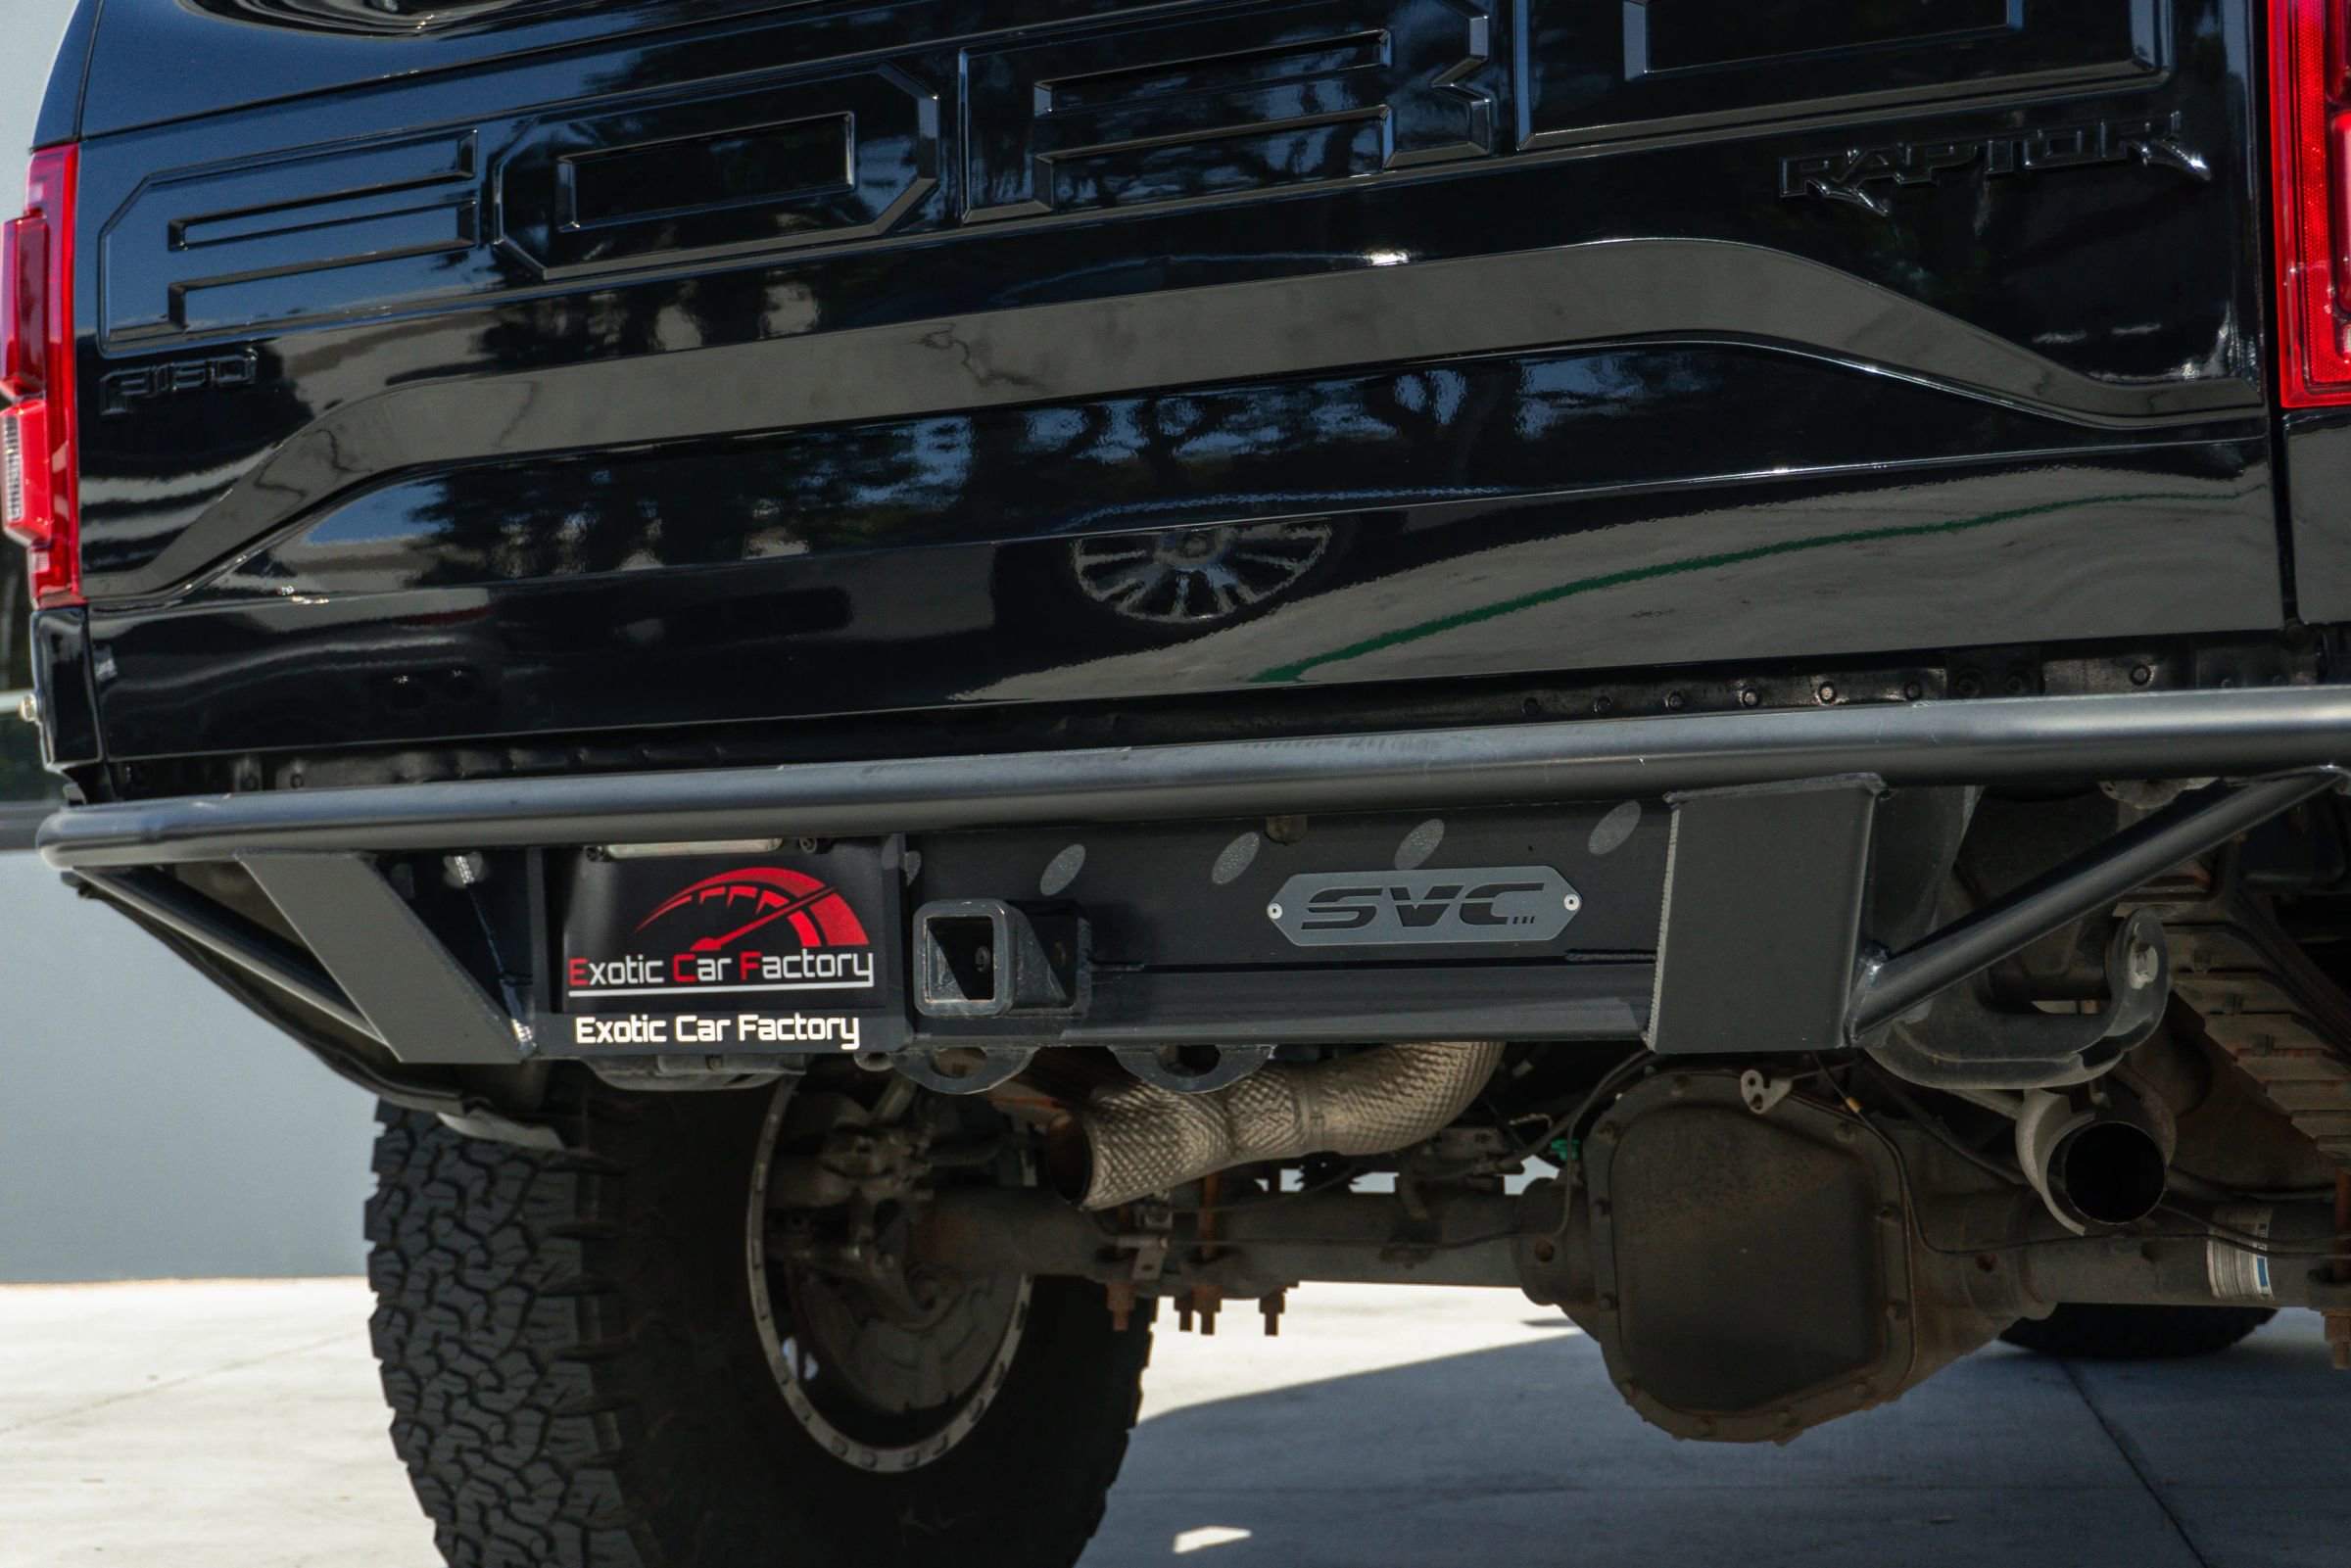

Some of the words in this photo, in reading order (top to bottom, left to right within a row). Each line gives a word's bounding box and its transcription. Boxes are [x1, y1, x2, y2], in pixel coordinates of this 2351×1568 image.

[1779, 111, 2212, 216] RAPTOR
[569, 954, 664, 986] Exotic
[673, 953, 732, 982] Car
[741, 948, 875, 987] Factory
[575, 1015, 667, 1044] Exotic
[675, 1015, 732, 1042] Car
[738, 1012, 861, 1050] Factory
